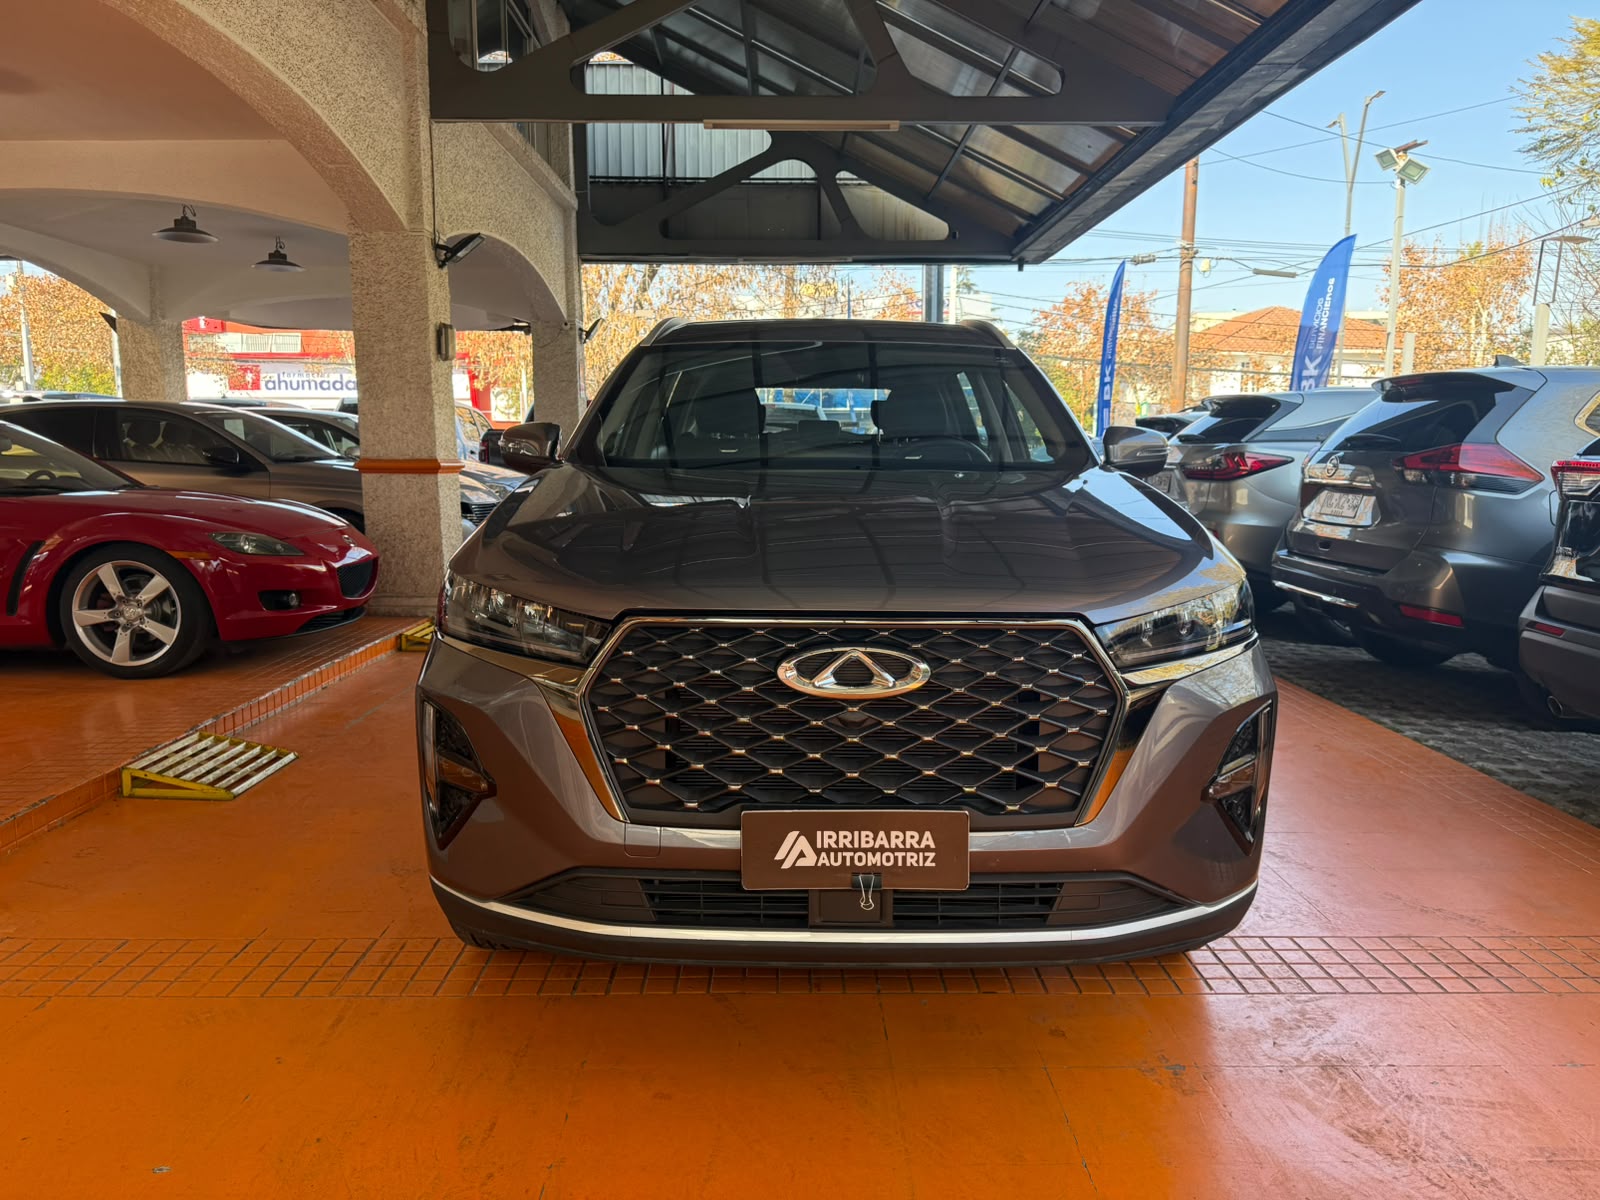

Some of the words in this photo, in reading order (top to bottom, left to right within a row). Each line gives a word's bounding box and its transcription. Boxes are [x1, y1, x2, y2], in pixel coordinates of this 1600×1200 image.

[1308, 297, 1324, 349] SERVICIOS
[1315, 277, 1336, 350] FINANCIEROS
[264, 373, 358, 391] ahumada
[816, 830, 936, 849] IRRIBARRA
[817, 852, 936, 867] AUTOMOTRIZ
